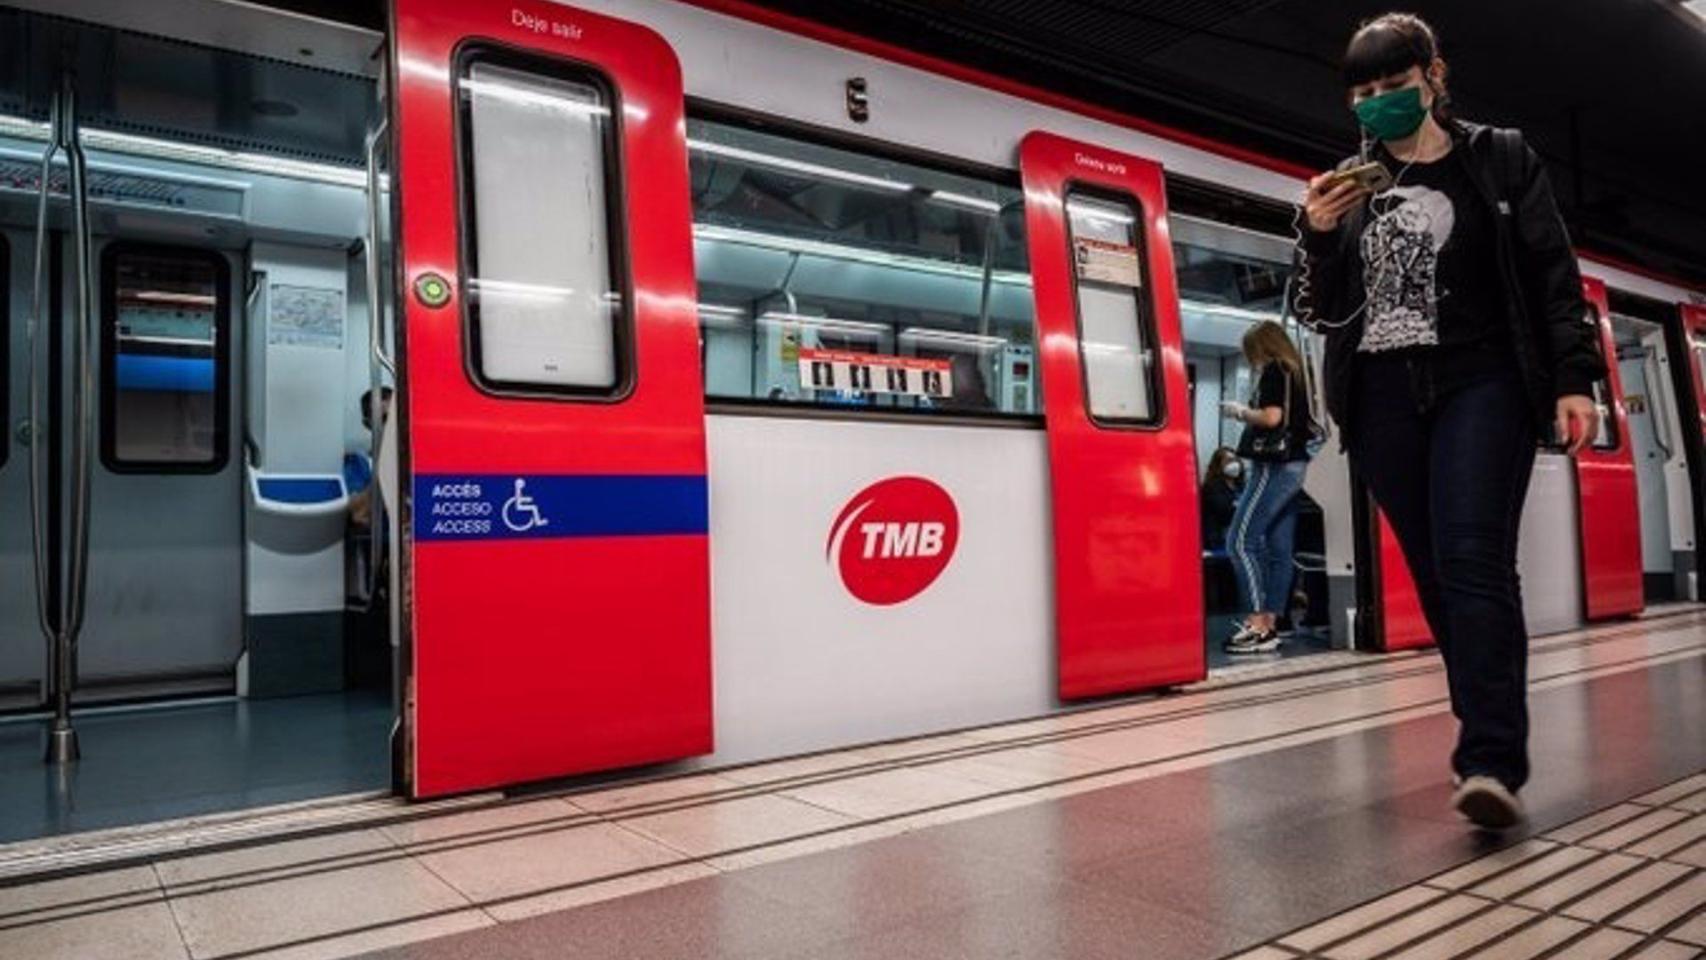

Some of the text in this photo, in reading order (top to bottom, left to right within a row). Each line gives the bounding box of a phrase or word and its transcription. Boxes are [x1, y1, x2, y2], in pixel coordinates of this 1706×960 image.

[511, 8, 583, 40] Deje salir
[432, 481, 482, 498] ACCÉS
[432, 502, 493, 516] ACCESO
[432, 519, 492, 533] ACCESS
[860, 521, 945, 559] TMB
